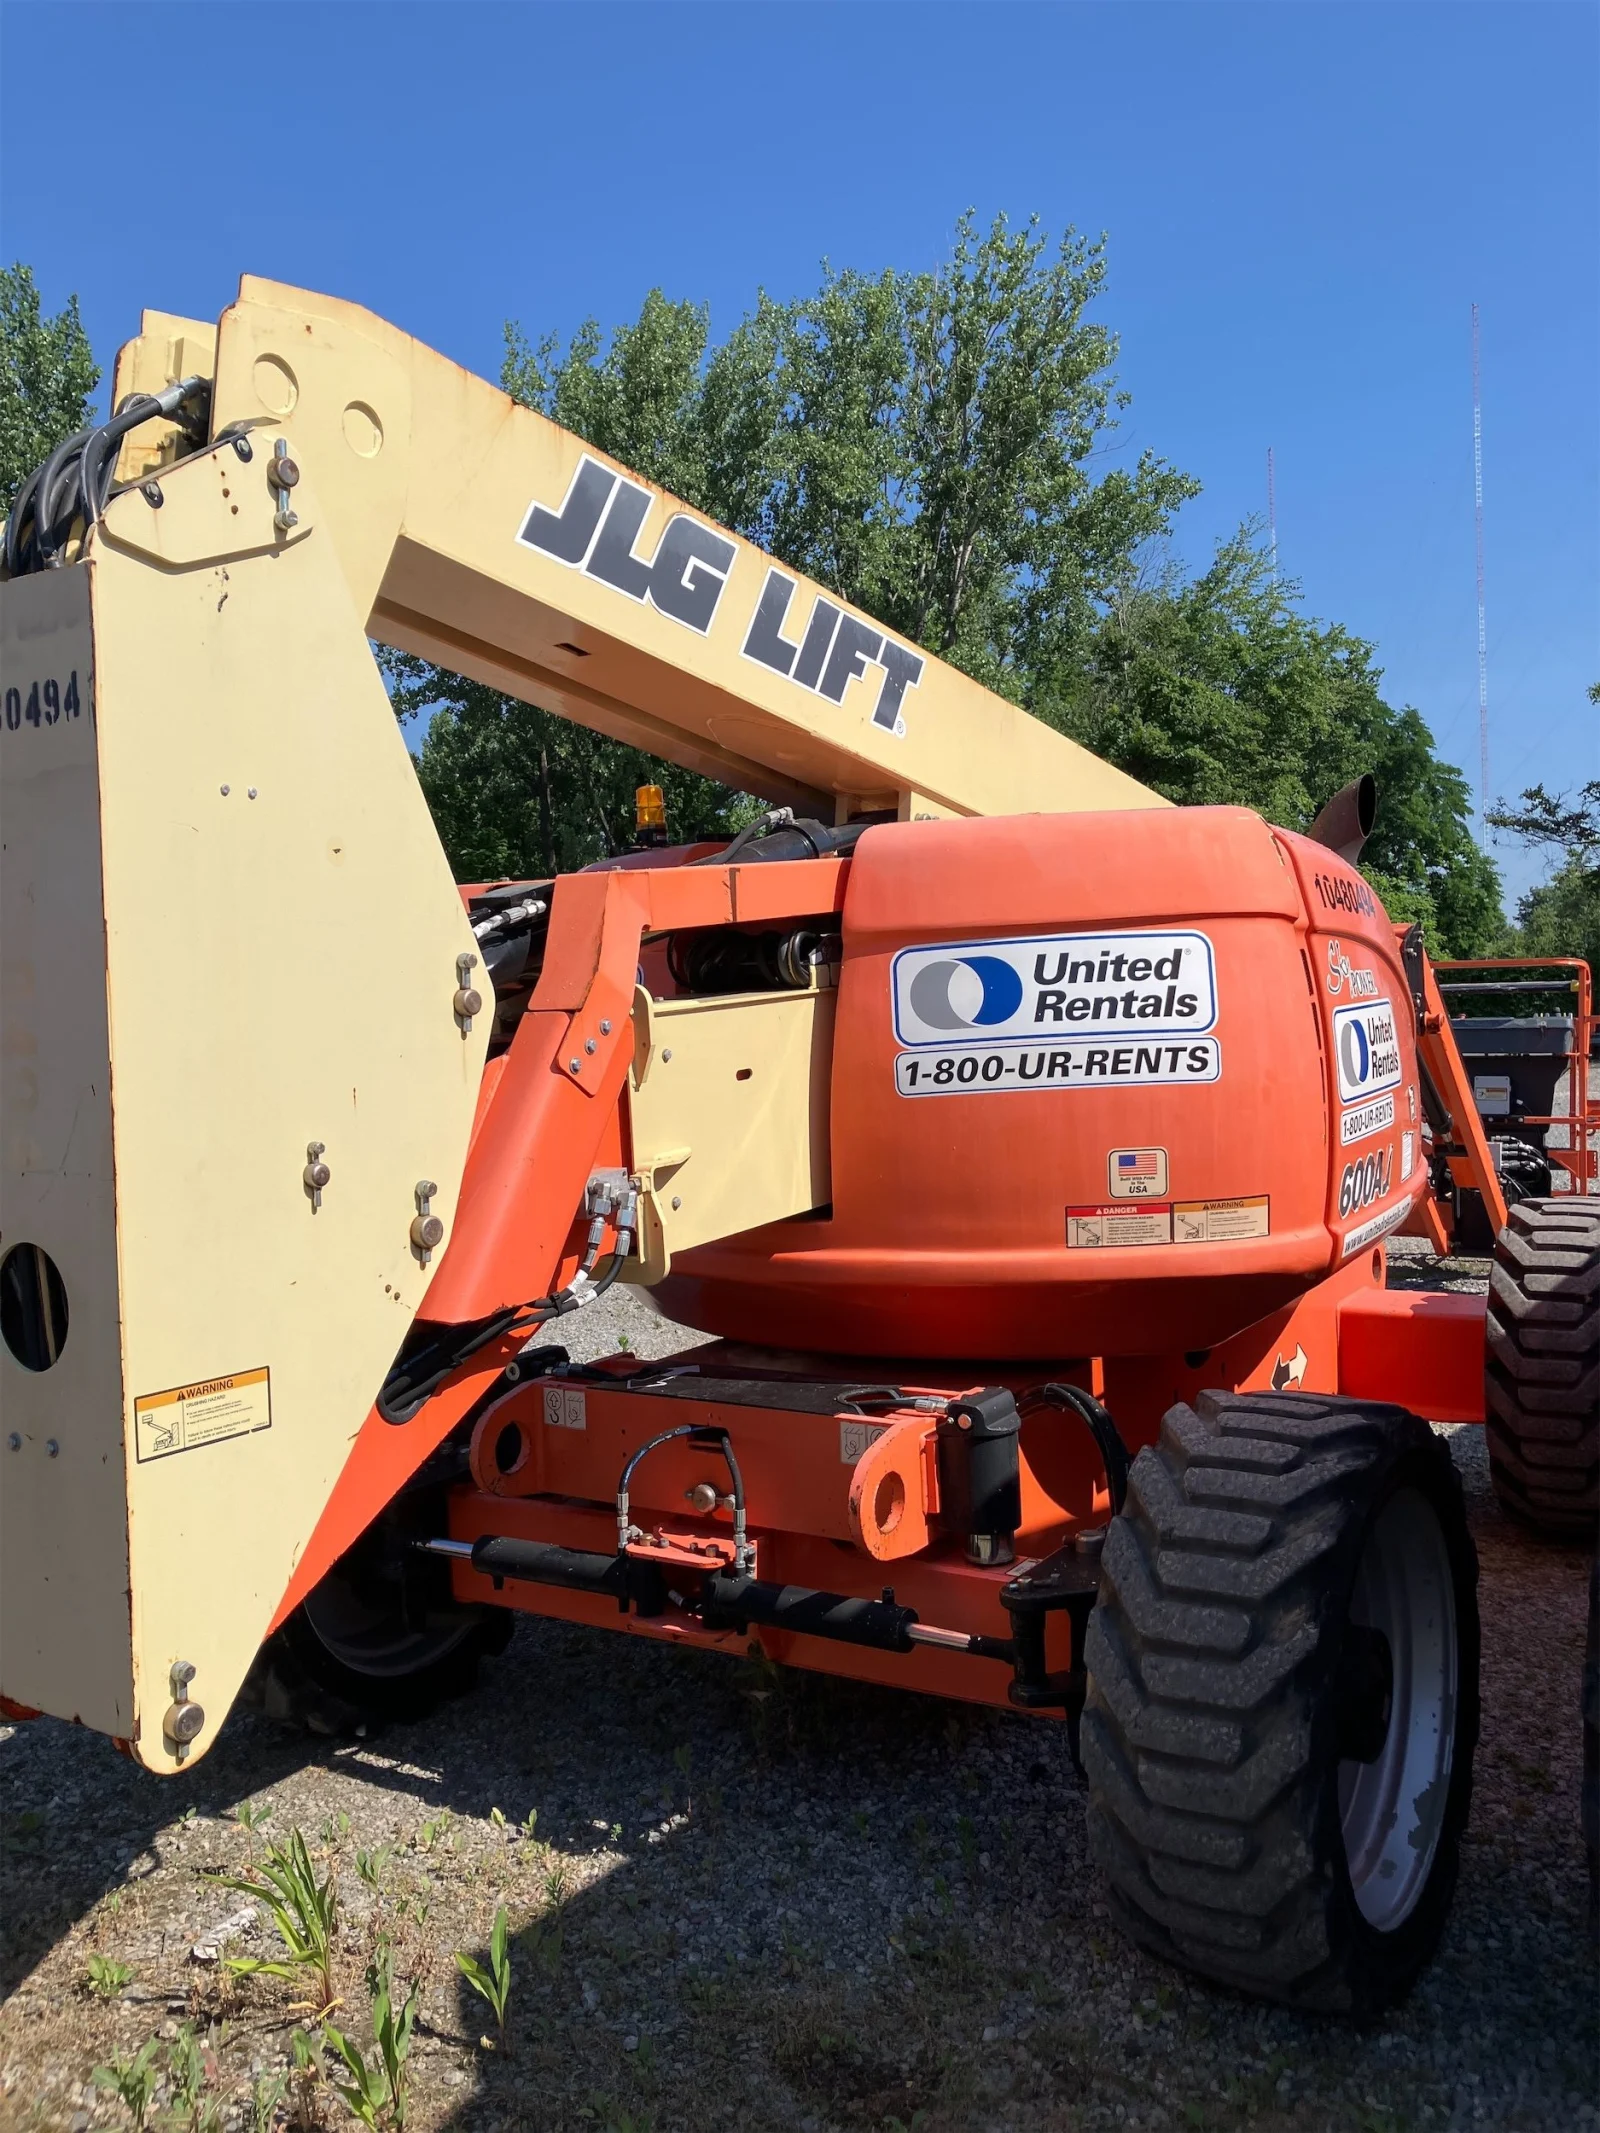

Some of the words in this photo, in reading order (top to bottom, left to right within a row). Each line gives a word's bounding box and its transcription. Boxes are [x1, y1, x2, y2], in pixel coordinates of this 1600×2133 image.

[515, 452, 740, 638] JLG
[739, 564, 926, 734] LIFT
[0, 670, 80, 731] 0494
[1034, 948, 1182, 985] United
[1034, 986, 1198, 1023] Rentals
[1368, 1013, 1393, 1046] United
[905, 1045, 1209, 1086] 1-800-UR-RENTS
[1372, 1045, 1398, 1079] Rentals
[1343, 1101, 1393, 1137] 1-800-UR-RENTS
[1129, 1185, 1148, 1193] USA
[1339, 1143, 1393, 1219] 600AJ
[1209, 1201, 1244, 1210] WARNING
[186, 1379, 234, 1399] WARNING
[186, 1398, 208, 1408] CRUSHING
[207, 1395, 226, 1403] HAZARD
